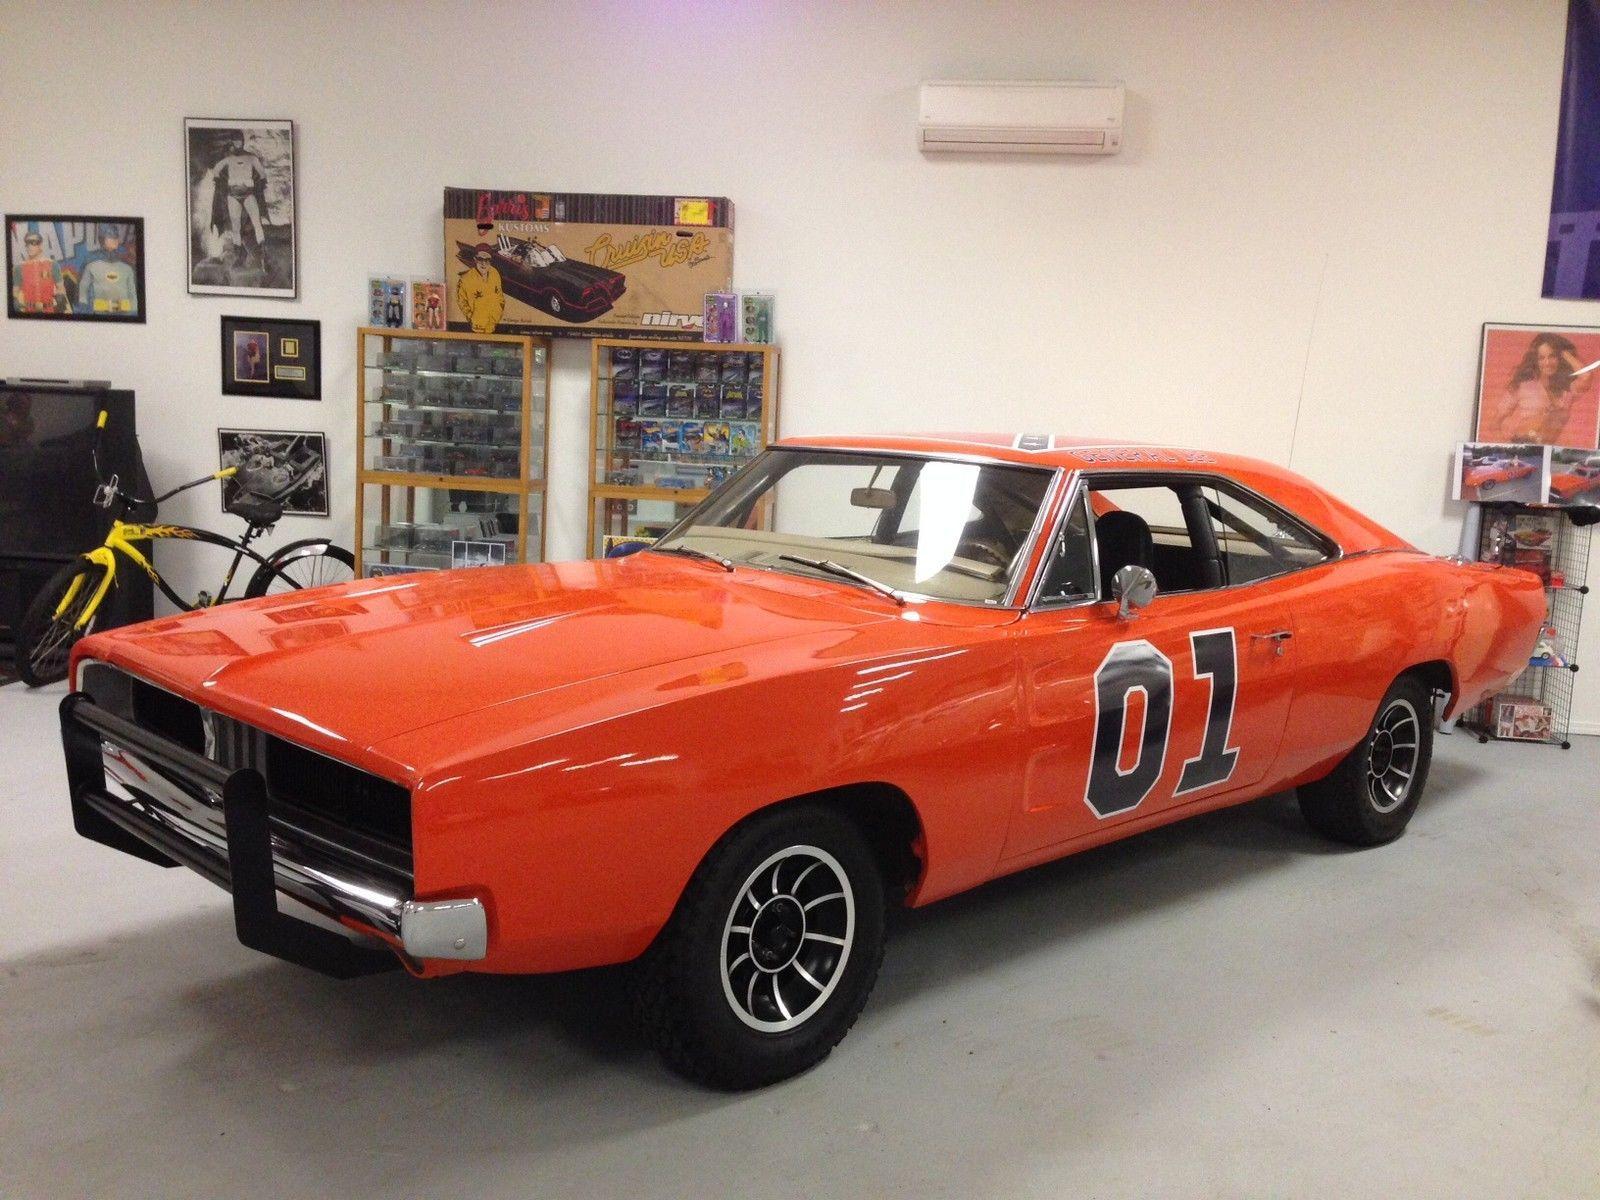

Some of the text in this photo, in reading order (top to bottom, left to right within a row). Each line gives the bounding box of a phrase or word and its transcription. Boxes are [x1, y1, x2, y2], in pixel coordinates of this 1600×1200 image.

[498, 222, 549, 234] KUSTOMS
[641, 311, 704, 329] nirv
[1070, 447, 1178, 463] GENERAL
[1083, 626, 1241, 820] 01
